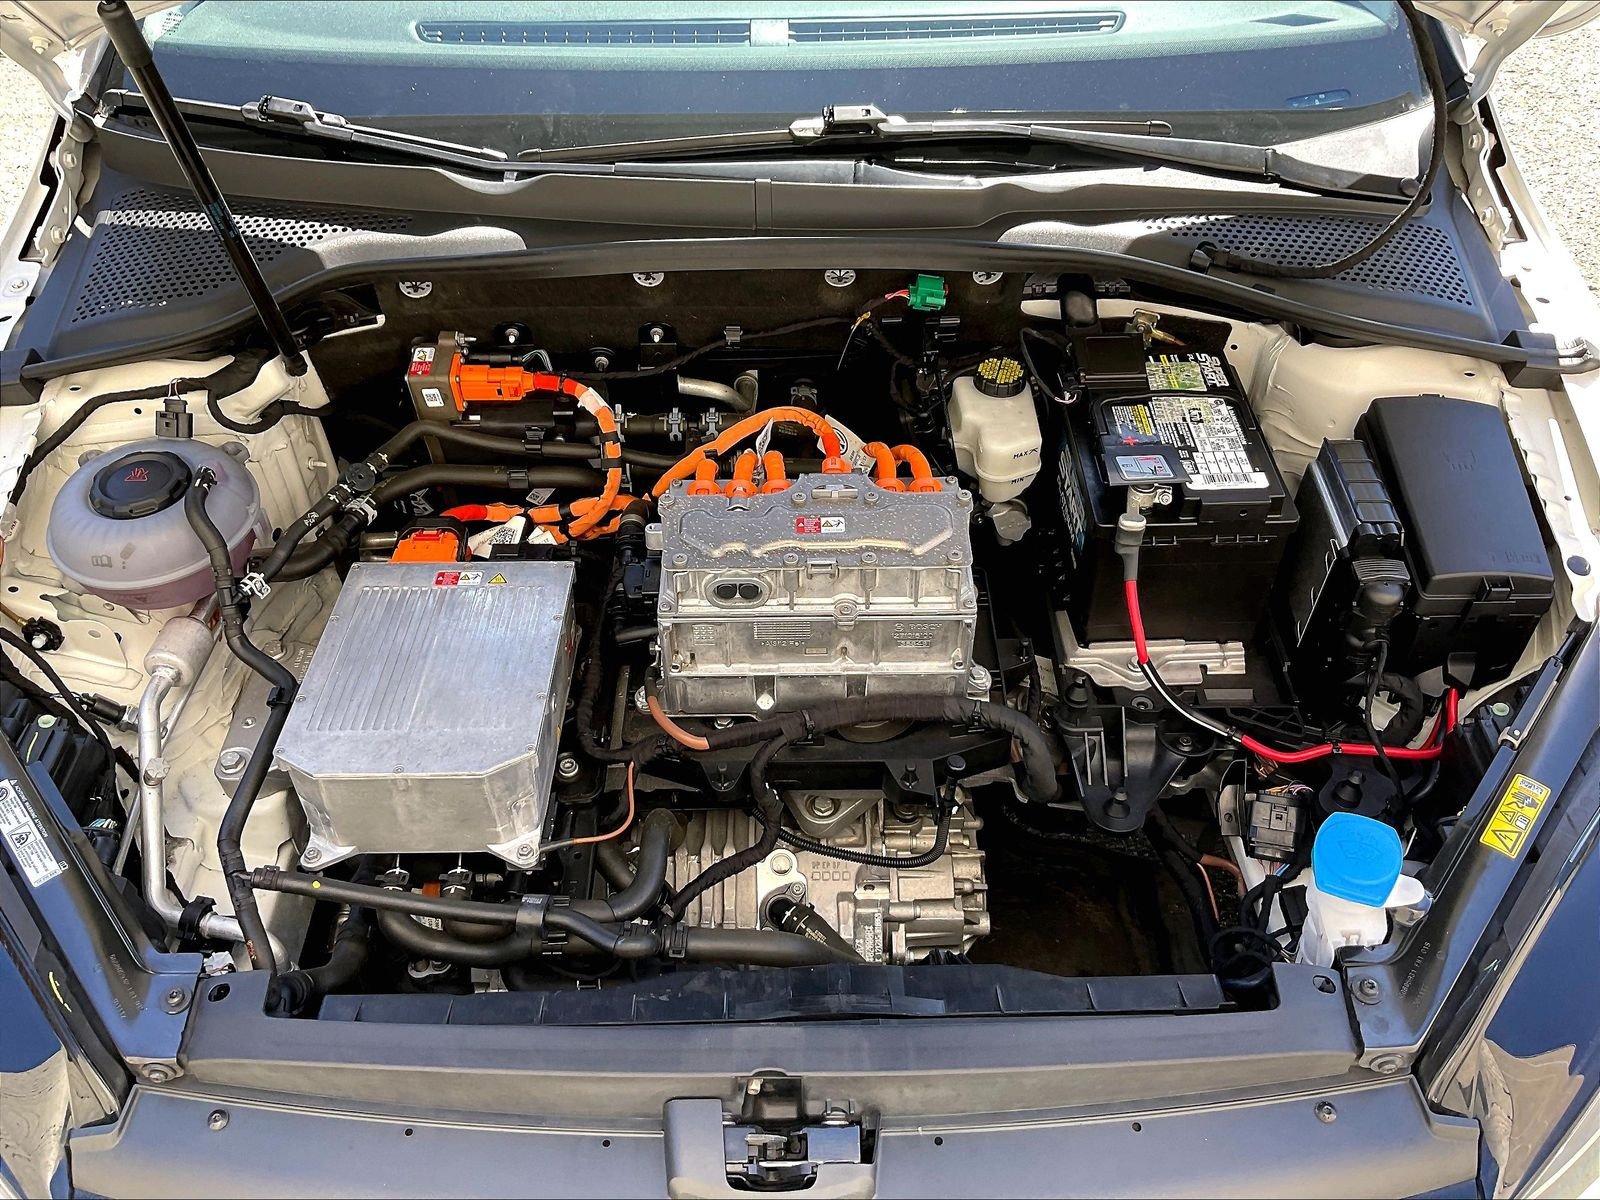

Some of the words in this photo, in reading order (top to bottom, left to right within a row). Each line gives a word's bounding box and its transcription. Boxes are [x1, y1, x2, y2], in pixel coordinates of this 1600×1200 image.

[1195, 352, 1216, 385] START
[1211, 356, 1230, 388] SUPER
[1013, 450, 1029, 459] MAX
[1011, 477, 1025, 485] MIN
[909, 622, 943, 630] BOSCH
